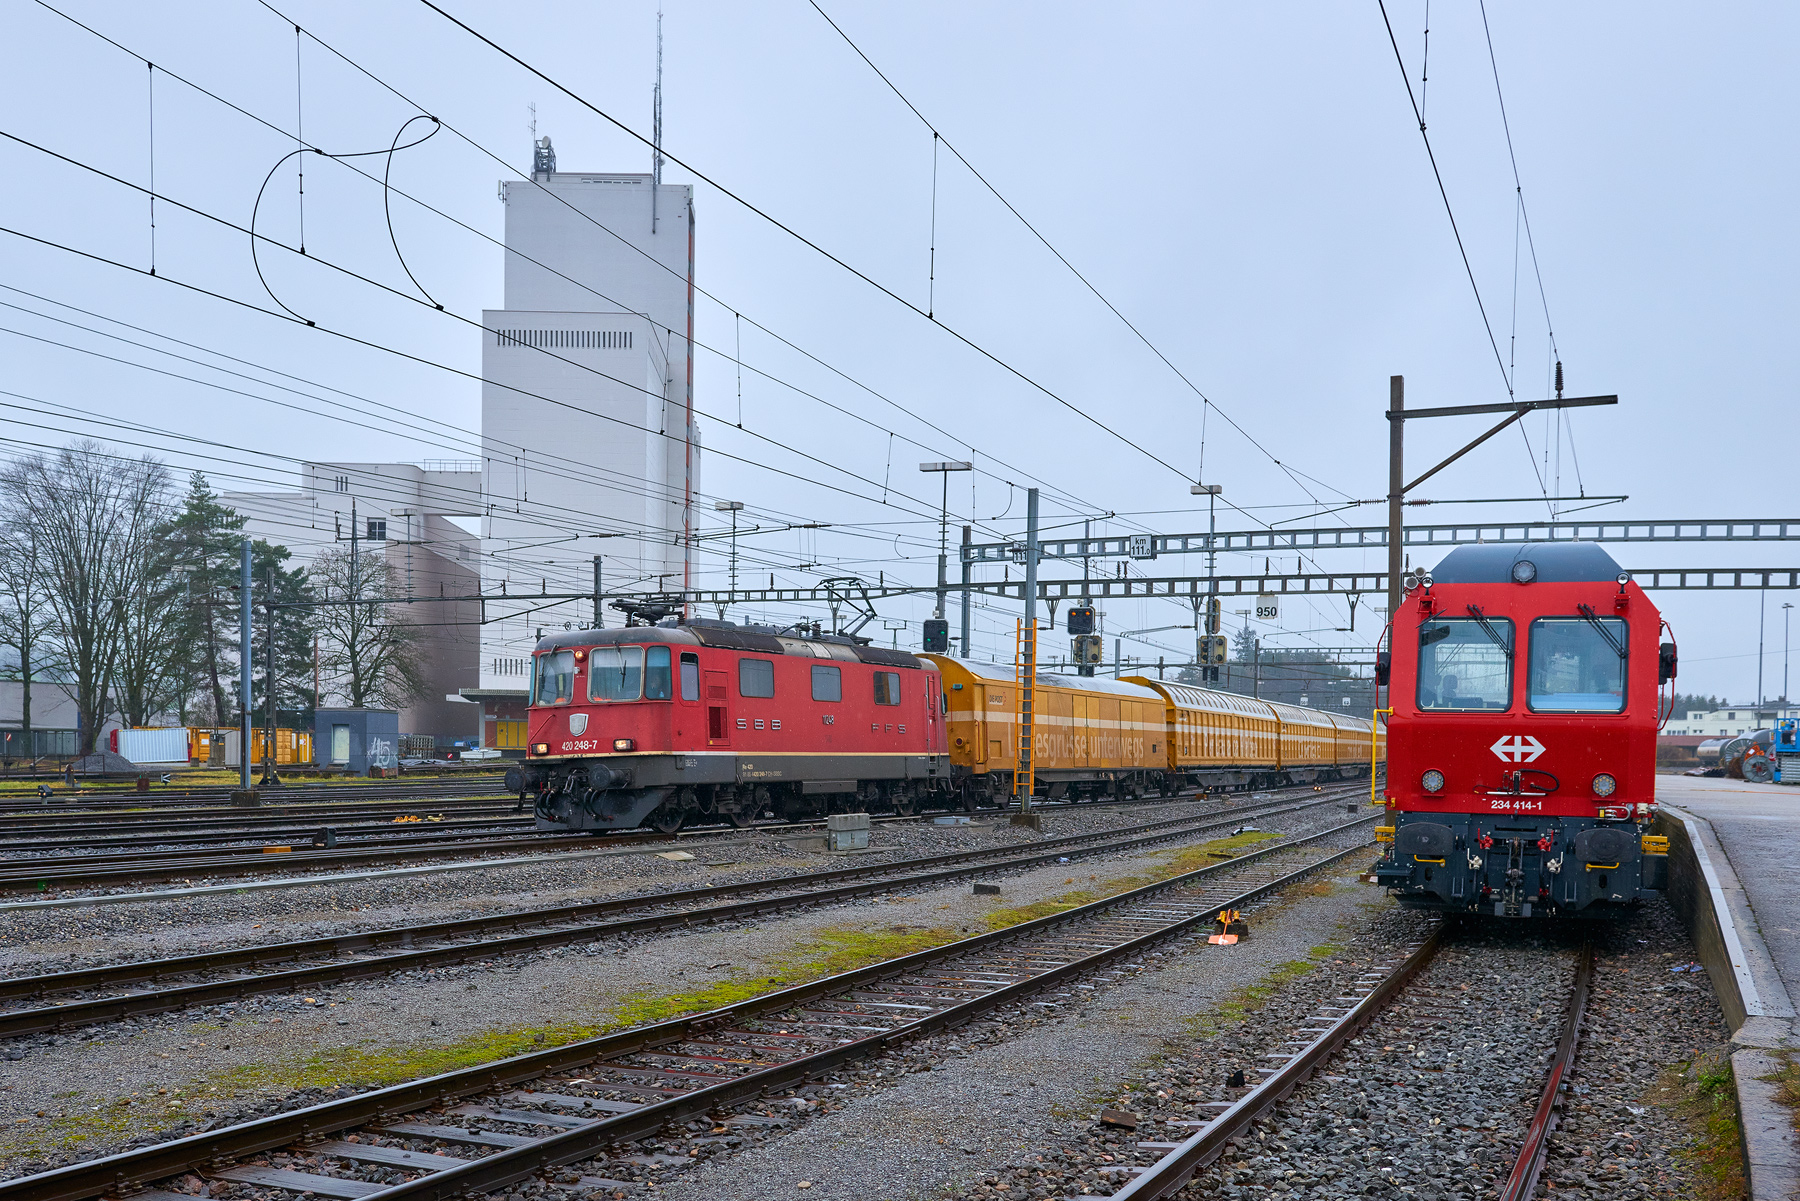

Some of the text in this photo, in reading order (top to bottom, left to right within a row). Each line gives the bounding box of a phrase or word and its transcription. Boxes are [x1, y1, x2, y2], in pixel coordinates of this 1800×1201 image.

[1135, 537, 1146, 545] km
[1256, 606, 1277, 617] 950
[736, 718, 782, 730] SBB
[822, 714, 835, 725] 11248
[871, 723, 907, 734] FFS
[561, 740, 598, 751] 420 248-7
[1090, 731, 1144, 766] unterwegs
[1491, 800, 1542, 810] 234 414-1
